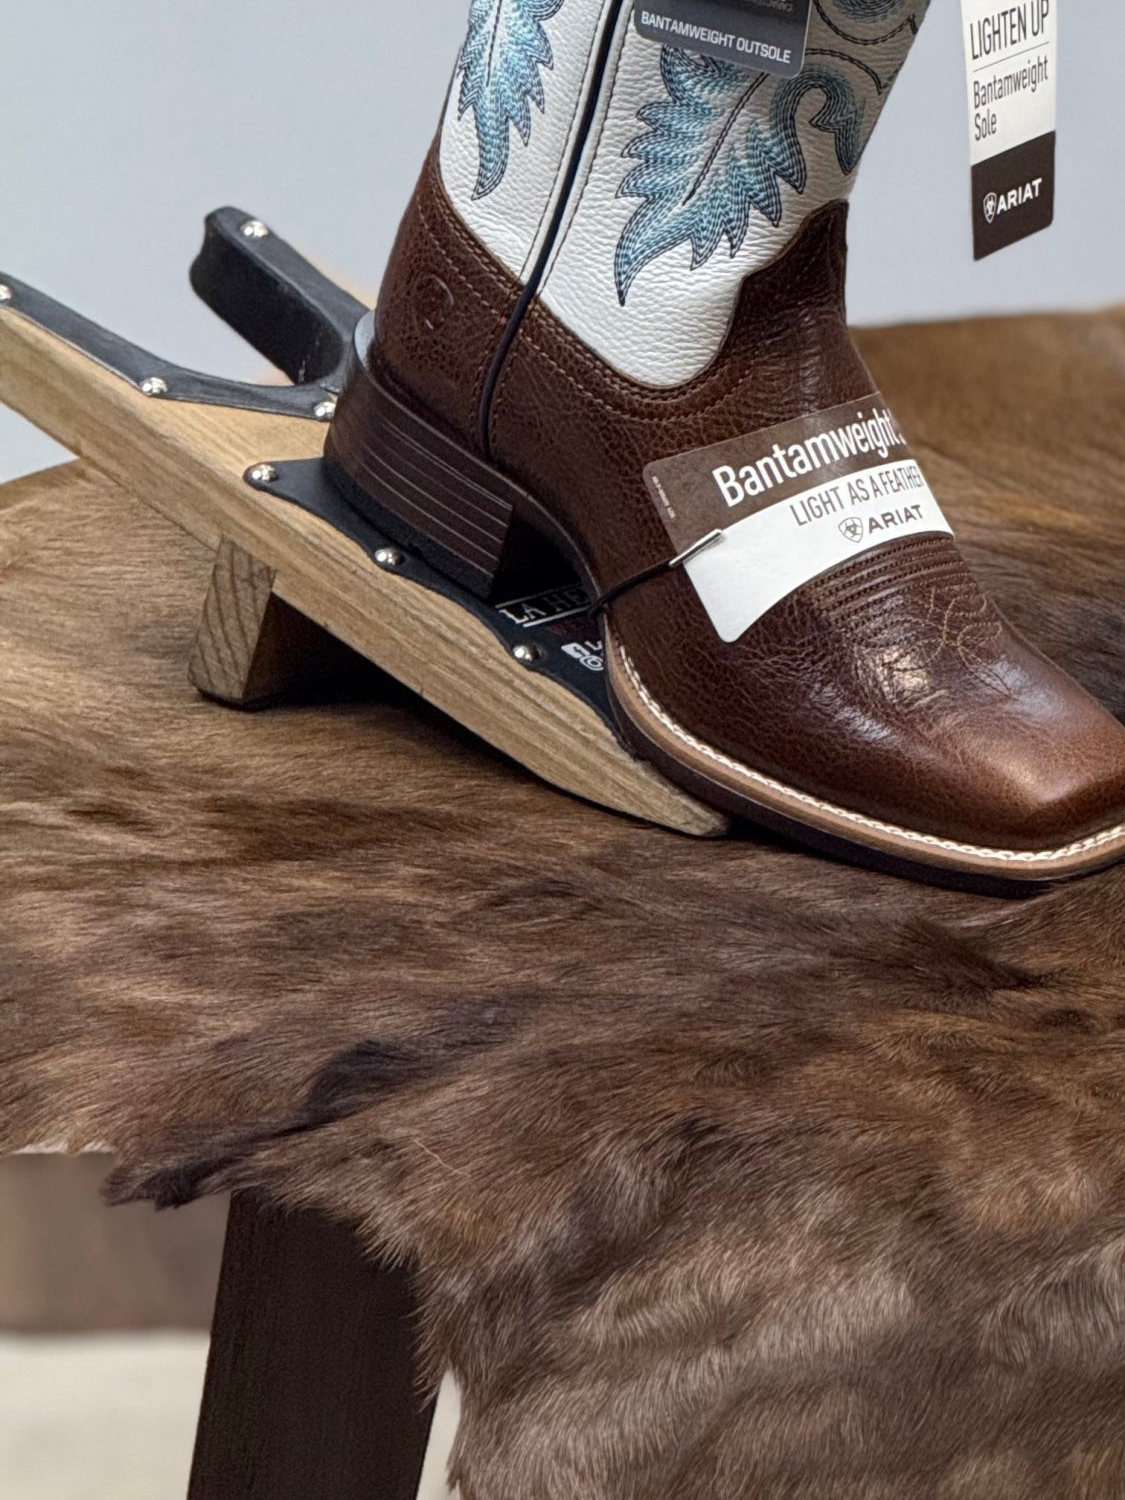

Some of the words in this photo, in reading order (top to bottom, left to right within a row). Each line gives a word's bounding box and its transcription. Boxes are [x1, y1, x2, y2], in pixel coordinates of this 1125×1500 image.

[641, 10, 736, 49] BANTAMWEIGHT
[736, 37, 792, 64] OUTSOLE
[970, 2, 1027, 61] LIGHTEN
[973, 55, 1048, 110] Bantamweight
[974, 108, 997, 141] Sole
[996, 178, 1043, 214] ARIAT
[790, 486, 845, 526] LIGHT
[849, 476, 870, 506] AS
[869, 475, 884, 499] A
[878, 465, 925, 496] FEATHE
[868, 504, 924, 534] ARIAT
